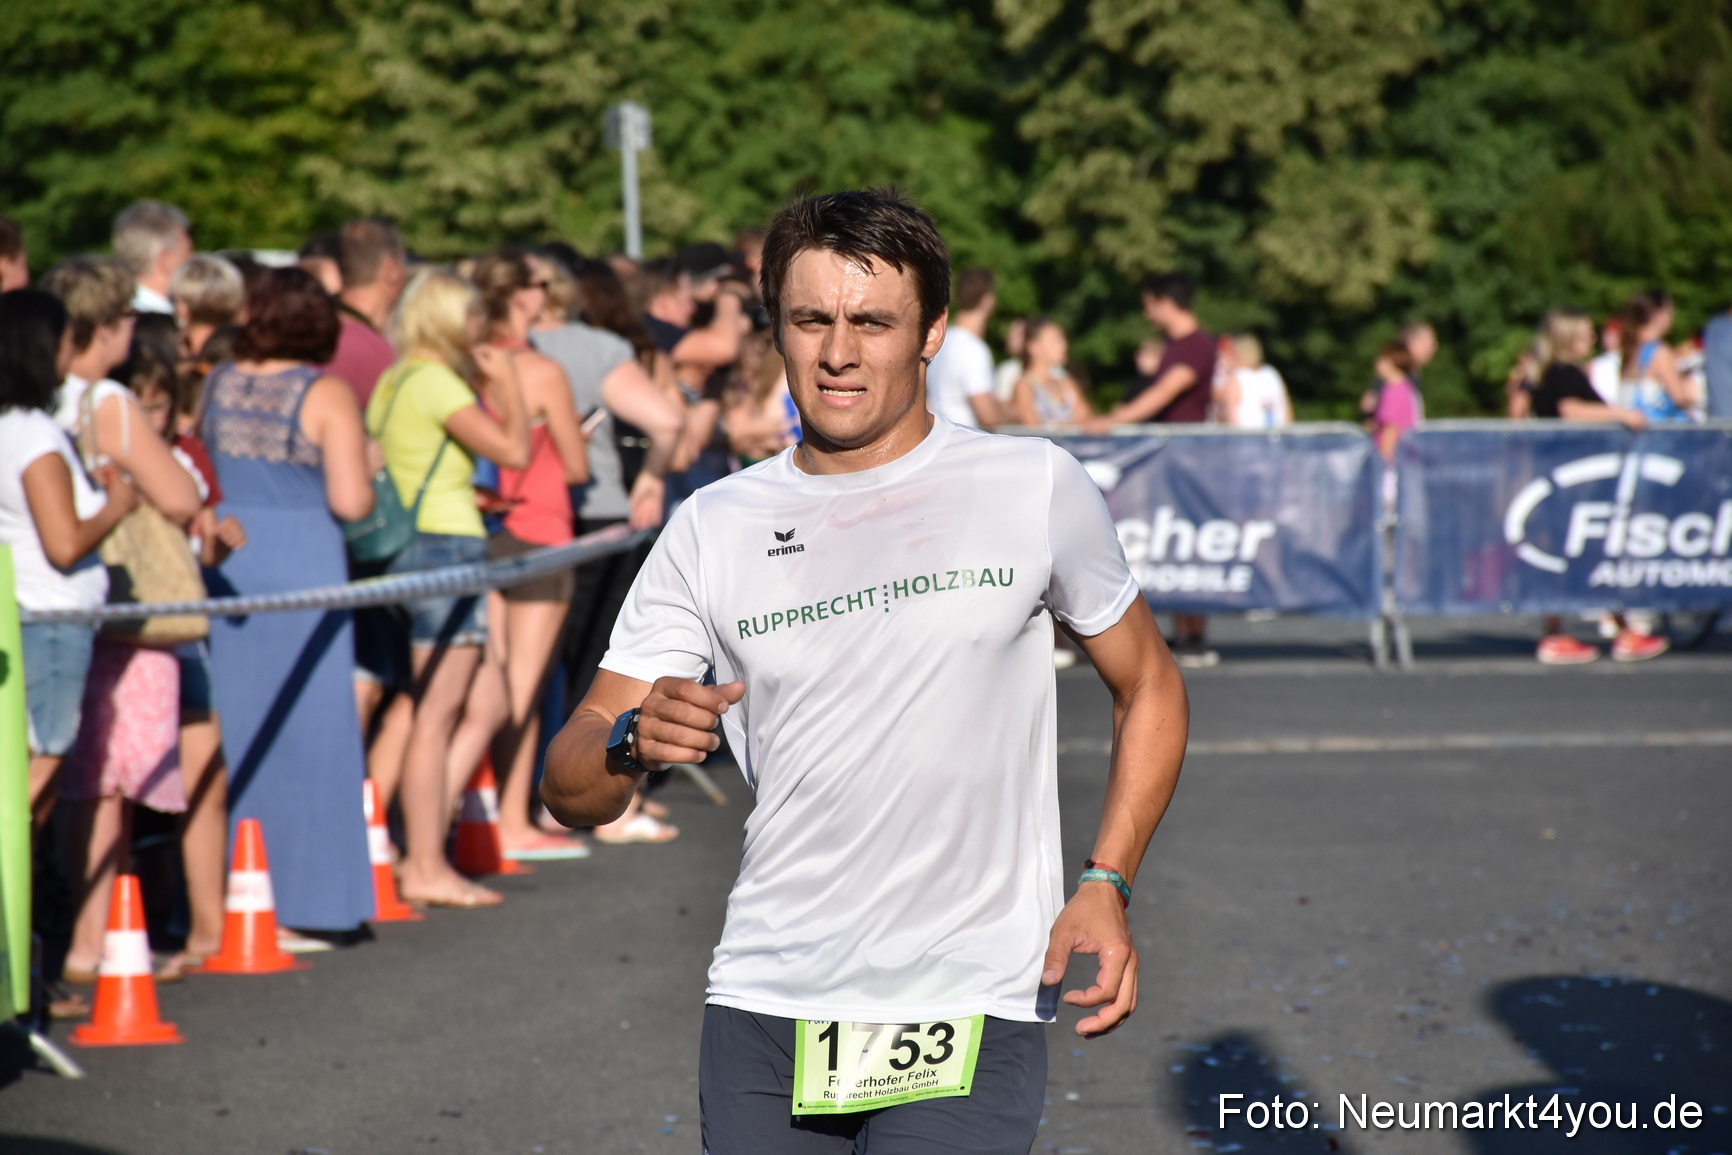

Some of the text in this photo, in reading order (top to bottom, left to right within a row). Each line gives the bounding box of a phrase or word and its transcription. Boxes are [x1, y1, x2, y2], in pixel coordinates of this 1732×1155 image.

[767, 543, 805, 557] erima
[1115, 505, 1277, 562] cher
[737, 568, 1014, 639] RUPPRECHT HOLZBAU
[818, 1021, 955, 1071] 1753
[823, 1090, 872, 1101] Rurecht
[874, 1085, 909, 1097] Holzbau
[911, 1079, 939, 1090] GmbH
[828, 1068, 938, 1088] Feerhofer Felix
